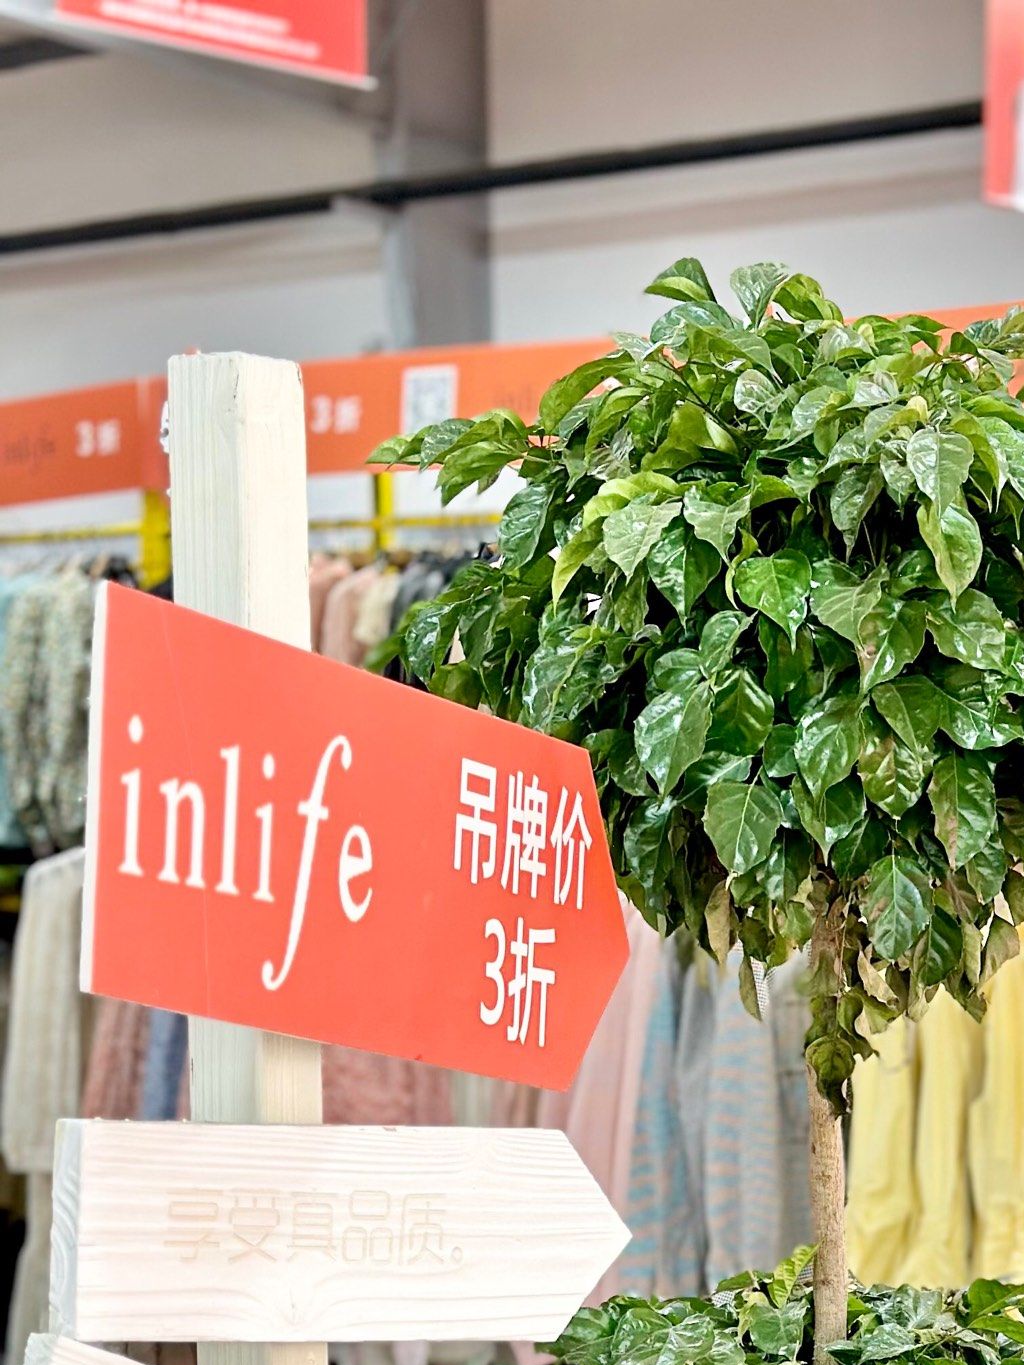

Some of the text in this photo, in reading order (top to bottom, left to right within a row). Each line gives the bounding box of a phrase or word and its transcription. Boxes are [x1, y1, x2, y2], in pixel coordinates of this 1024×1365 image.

[118, 714, 374, 992] inlife
[452, 756, 594, 911] 吊牌价
[479, 916, 557, 1049] 3折
